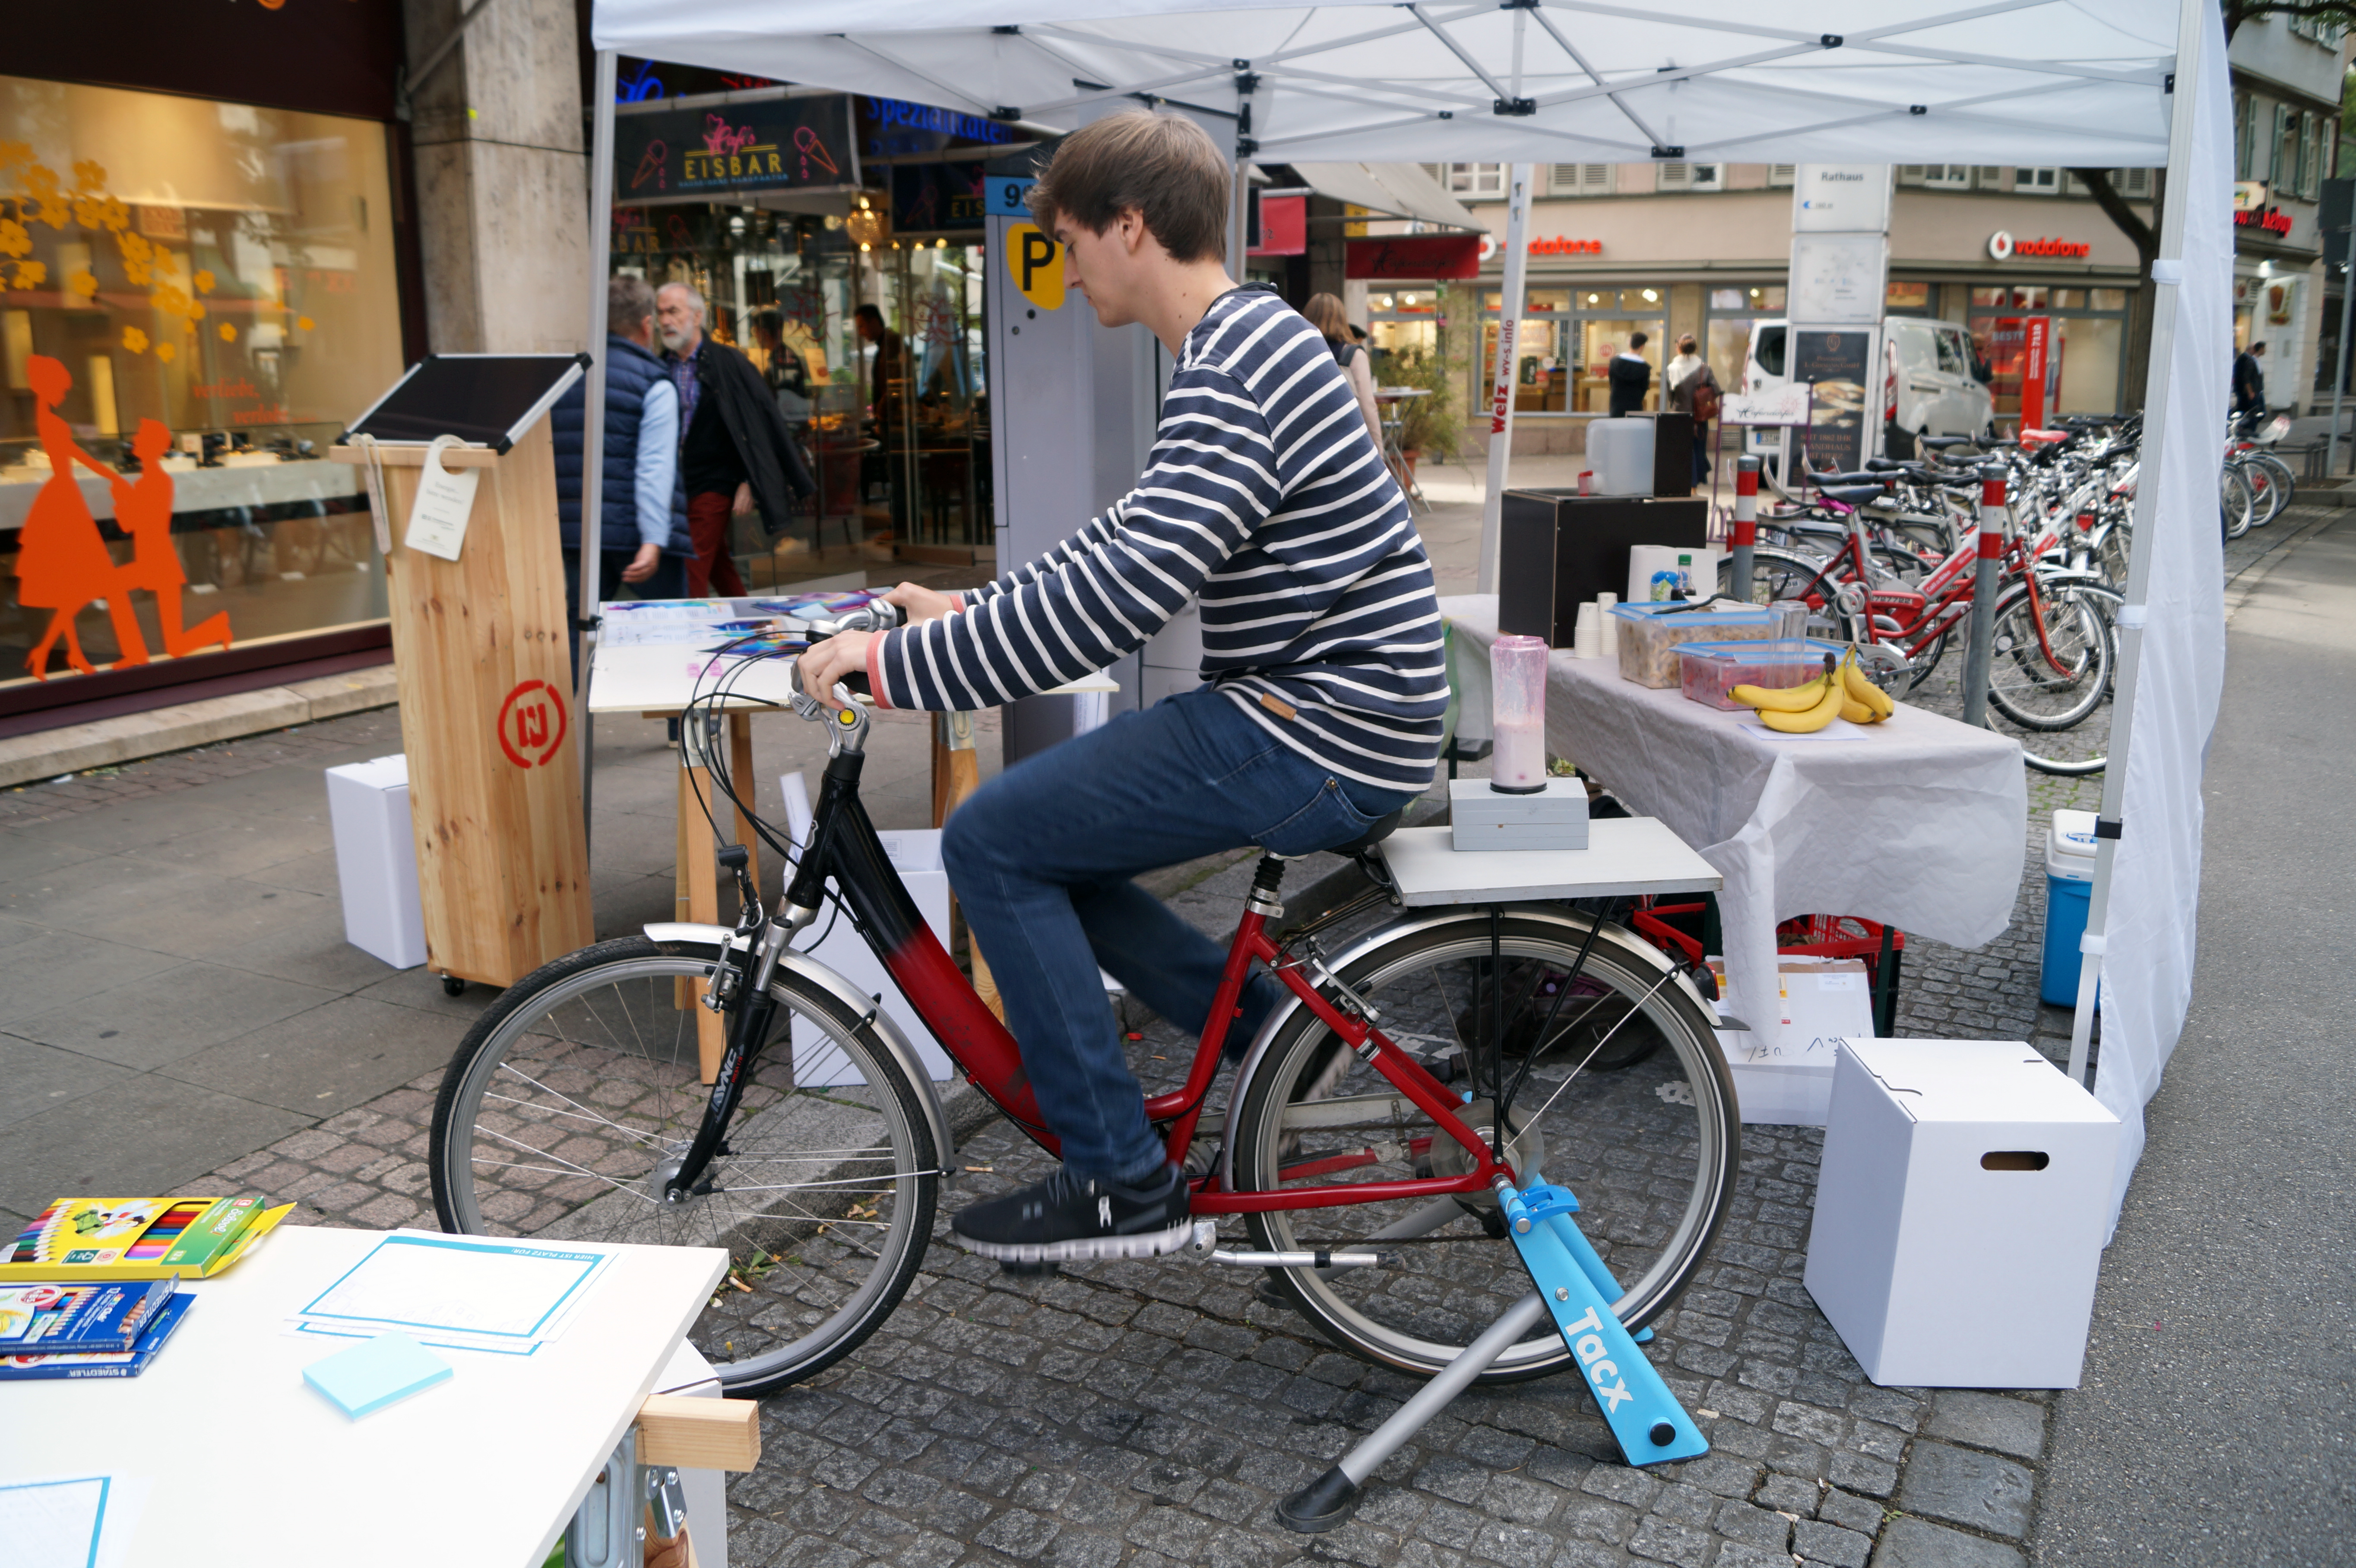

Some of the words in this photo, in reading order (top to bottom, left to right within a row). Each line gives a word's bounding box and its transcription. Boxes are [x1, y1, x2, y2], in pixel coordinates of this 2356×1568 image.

[685, 153, 782, 179] EISBAR
[1821, 171, 1863, 181] Rathaus
[2014, 237, 2091, 258] vodafone
[1023, 232, 1055, 291] P
[1501, 319, 1514, 376] wv-s.info
[2033, 325, 2042, 347] 7110
[1938, 570, 1951, 581] Bike
[139, 1283, 169, 1328] STAEDTLER
[1565, 1306, 1634, 1414] Tacx
[70, 1368, 119, 1378] STAEDTLER
